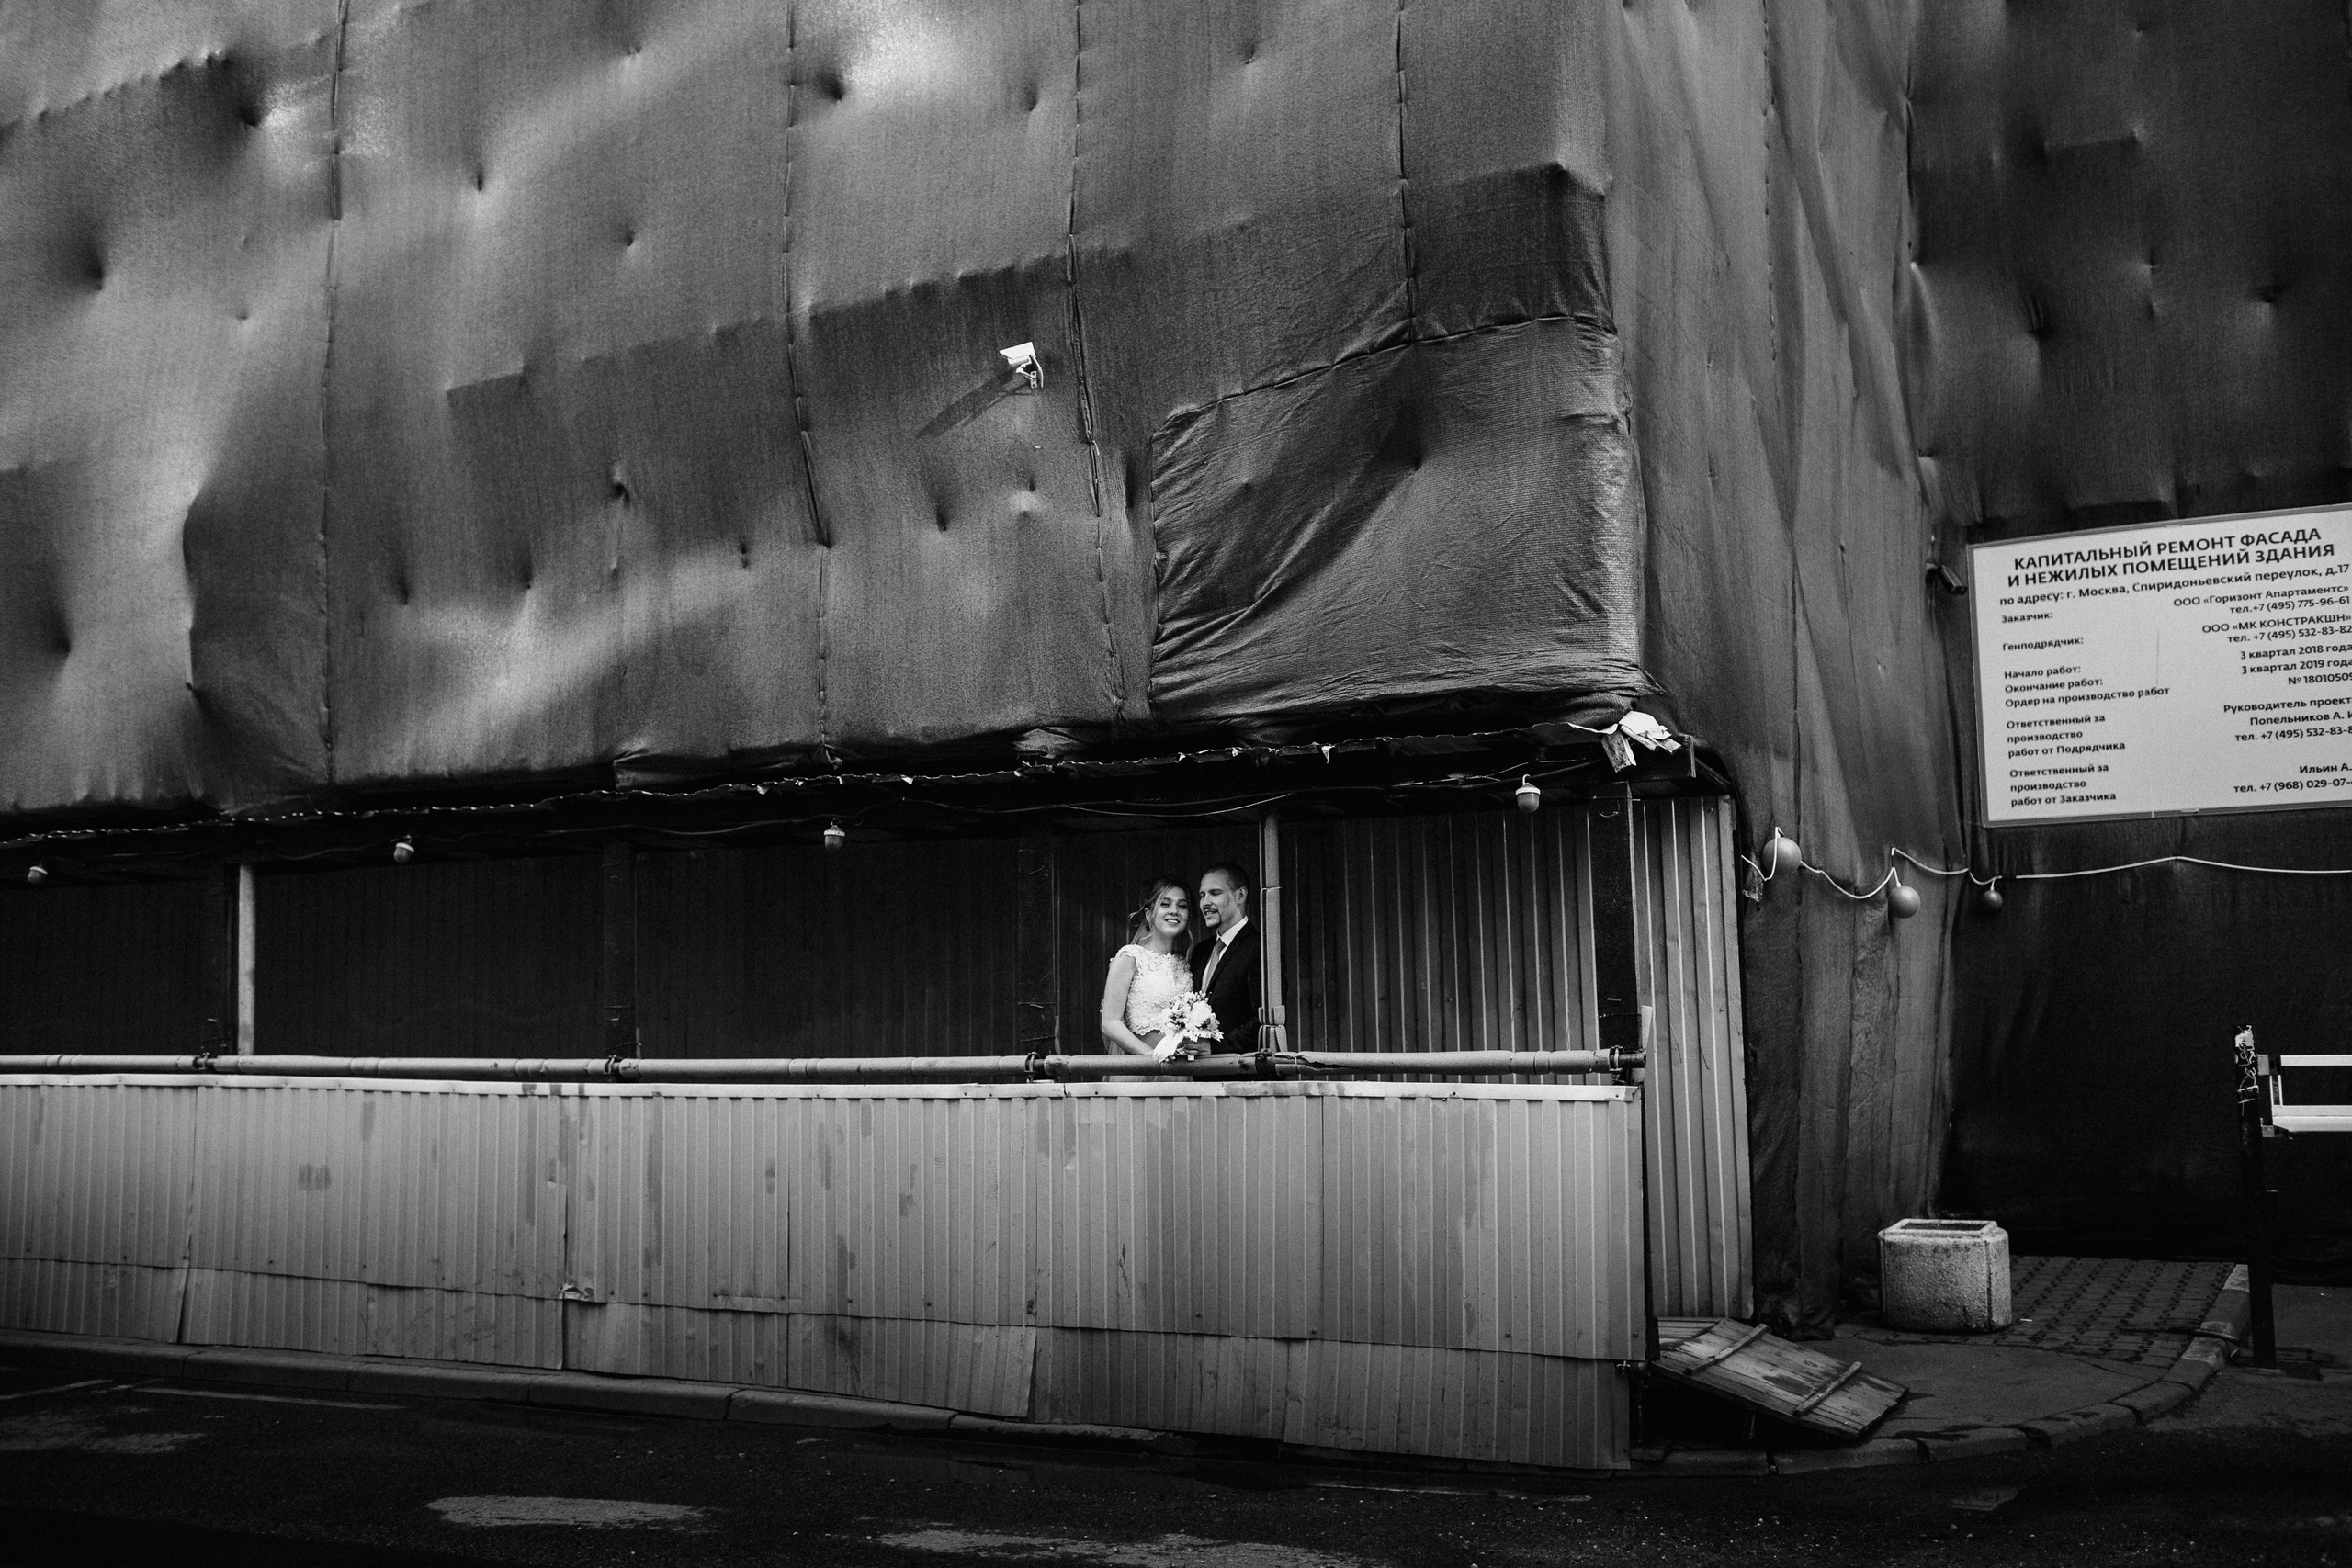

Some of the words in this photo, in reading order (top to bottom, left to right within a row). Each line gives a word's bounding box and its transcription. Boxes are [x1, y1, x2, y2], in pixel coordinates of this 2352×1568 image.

[2014, 541, 2152, 570] КАПИТАЛЬНЫЙ
[2157, 536, 2235, 554] РЕМОНТ
[2239, 528, 2321, 551] ФАСАДА
[2007, 574, 2019, 587] И
[2025, 564, 2118, 585] НЕЖИЛЫХ
[2122, 548, 2249, 575] ПОМЕЩЕНИЙ
[2255, 543, 2335, 564] ЗДАНИЯ
[1999, 597, 2014, 605] по
[2017, 592, 2064, 604] адресу:
[2078, 586, 2129, 597] Москва,
[2132, 572, 2251, 592] Спиридоньевский
[2255, 569, 2322, 581] переулок,
[2324, 563, 2349, 576] д.17
[2173, 596, 2200, 606] ООО
[2203, 592, 2262, 604] «Горизонт
[2265, 585, 2348, 599] Апартаментс»
[2267, 600, 2295, 612] (495)
[2297, 595, 2349, 607] 775-96-61
[2002, 612, 2053, 623] Заказчик:
[2202, 623, 2229, 633] ООО
[2233, 621, 2256, 630] «МК
[2259, 613, 2351, 628] КОНСТРАКШН»
[2253, 632, 2265, 640] +7
[2267, 629, 2295, 641] (495)
[2298, 625, 2352, 637] 532-83-82
[2003, 637, 2084, 651] Генподрядчик:
[2240, 650, 2245, 660] 3
[2248, 649, 2295, 659] квартал
[2298, 645, 2324, 654] 2018
[2325, 644, 2352, 653] года
[2004, 670, 2043, 679] Начало
[2046, 665, 2081, 677] работ:
[2242, 665, 2247, 674] 3
[2250, 663, 2297, 673] квартал
[2300, 660, 2324, 670] 2019
[2005, 682, 2065, 693] Окончание
[2067, 678, 2103, 690] работ:
[2288, 676, 2301, 684] №
[2005, 698, 2040, 708] Ордер
[2058, 691, 2134, 705] производство
[2137, 686, 2169, 698] работ
[2223, 701, 2307, 715] Руководитель
[2007, 715, 2091, 728] Ответственный
[2250, 714, 2330, 725] Попельников
[2333, 711, 2345, 719] А.
[2007, 731, 2083, 744] производство
[2261, 730, 2272, 739] +7
[2275, 728, 2303, 740] (495)
[2007, 748, 2038, 759] работ
[2056, 742, 2125, 754] Подрядчика
[2009, 764, 2095, 777] Ответственный
[2299, 765, 2337, 773] Ильин
[2010, 781, 2086, 794] производство
[2233, 784, 2256, 793] тел.
[2259, 782, 2271, 791] +7
[2274, 780, 2303, 792] (968)
[2306, 777, 2352, 788] 029-07-
[2011, 796, 2041, 807] работ
[2060, 793, 2116, 803] Заказчика
